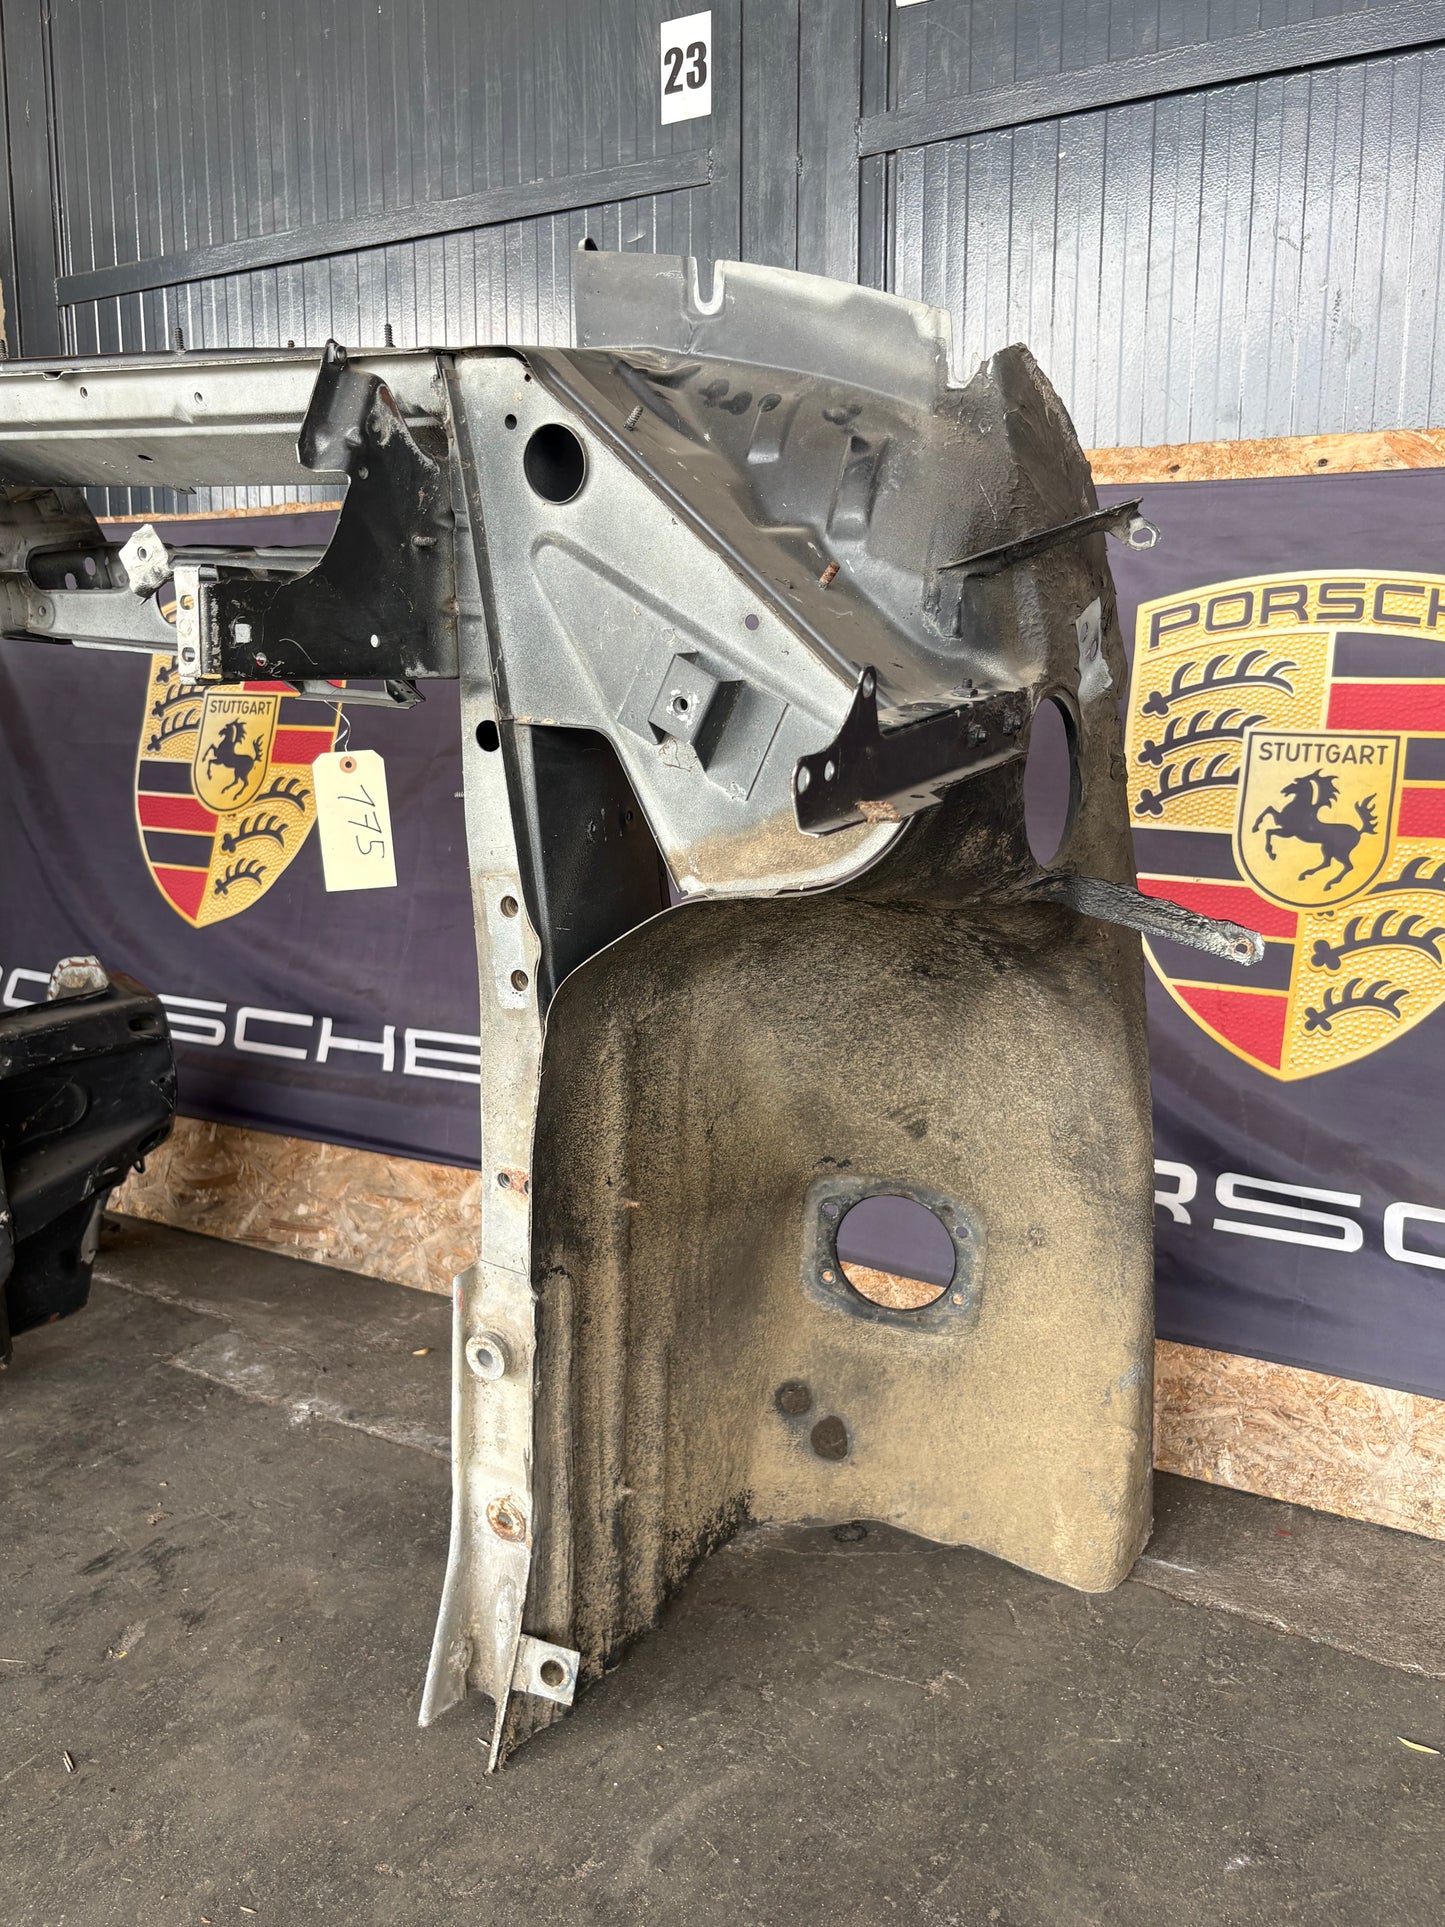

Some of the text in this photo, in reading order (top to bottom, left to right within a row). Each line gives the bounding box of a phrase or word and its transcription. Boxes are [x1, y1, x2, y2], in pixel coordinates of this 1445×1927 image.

[664, 41, 707, 95] 23
[210, 700, 272, 715] STUTTGART
[1259, 742, 1388, 765] STUTTGART
[337, 785, 385, 858] 175
